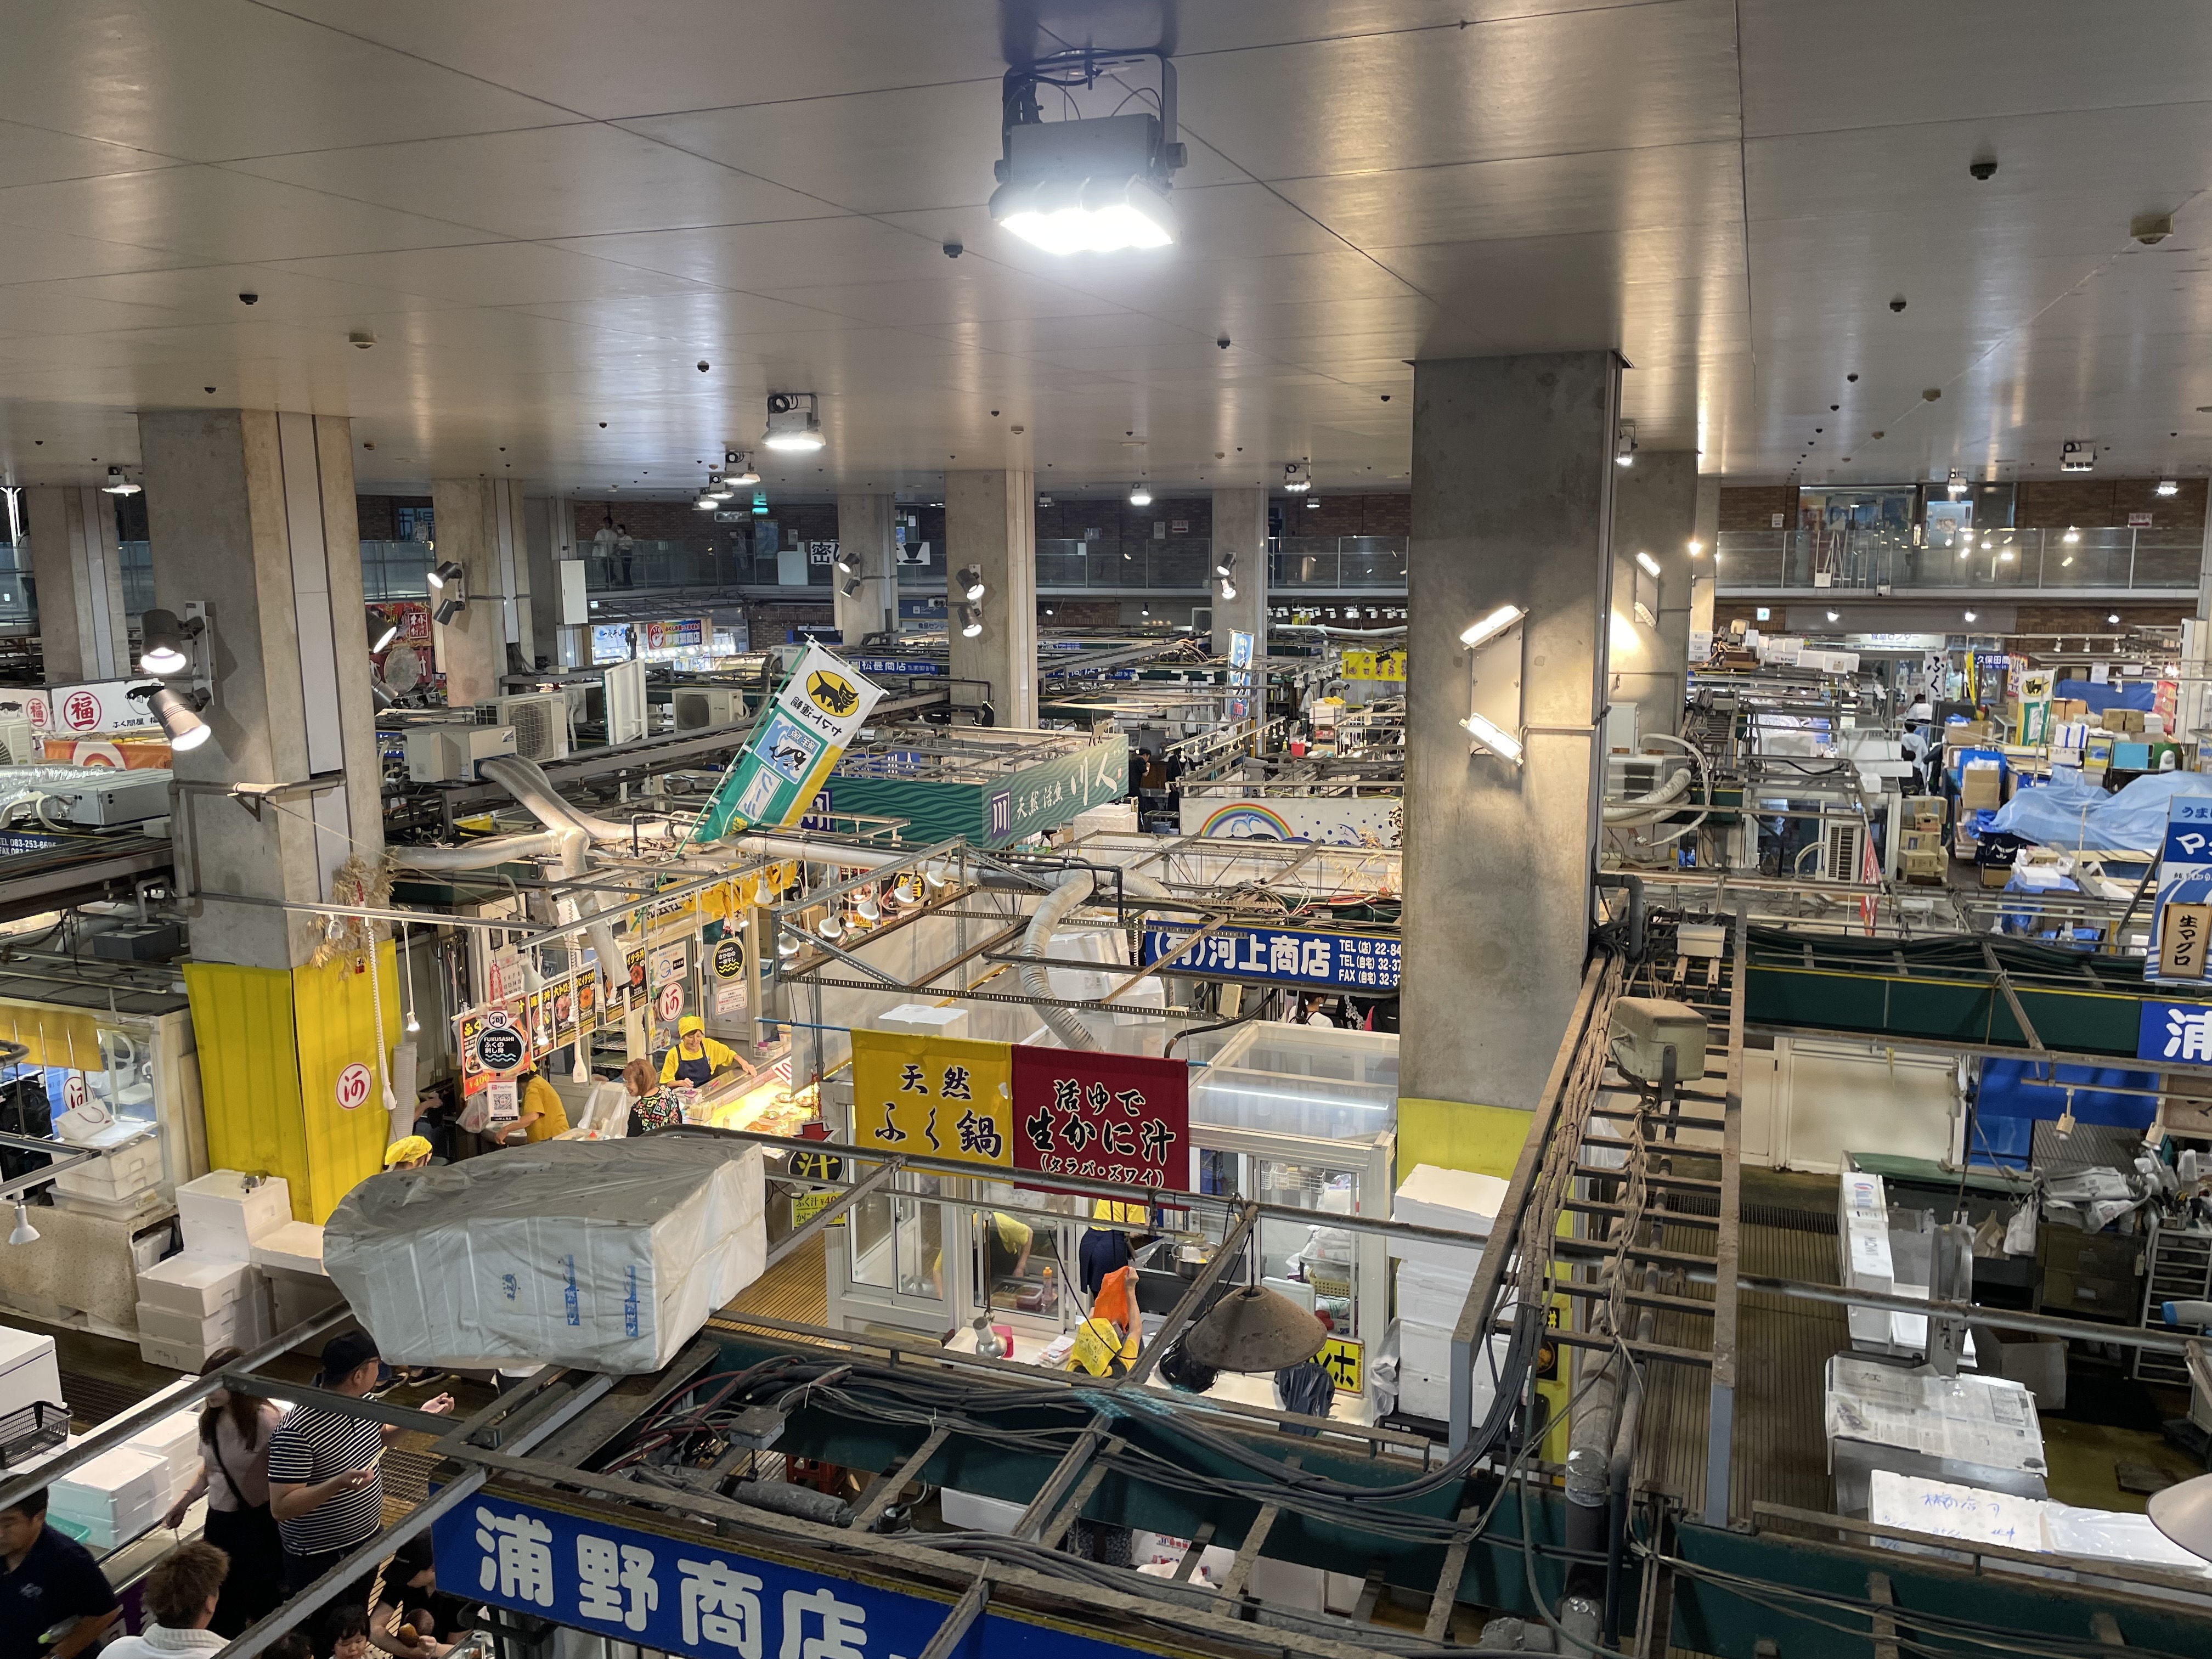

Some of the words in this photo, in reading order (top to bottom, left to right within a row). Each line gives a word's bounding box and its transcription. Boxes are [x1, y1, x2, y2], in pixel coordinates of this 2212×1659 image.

[1339, 939, 1356, 953] TEL
[1339, 954, 1355, 967] TEL
[1339, 969, 1356, 982] FAX
[900, 1064, 972, 1100] 天然
[1053, 1078, 1147, 1117] 活ゆで
[875, 1102, 1002, 1159] ふく鍋
[1025, 1105, 1176, 1166] 生かに汁
[1041, 1153, 1164, 1188] (タラバ・ズワイ)
[795, 1196, 819, 1207] ふく汁
[476, 1505, 867, 1659] 浦野商店
